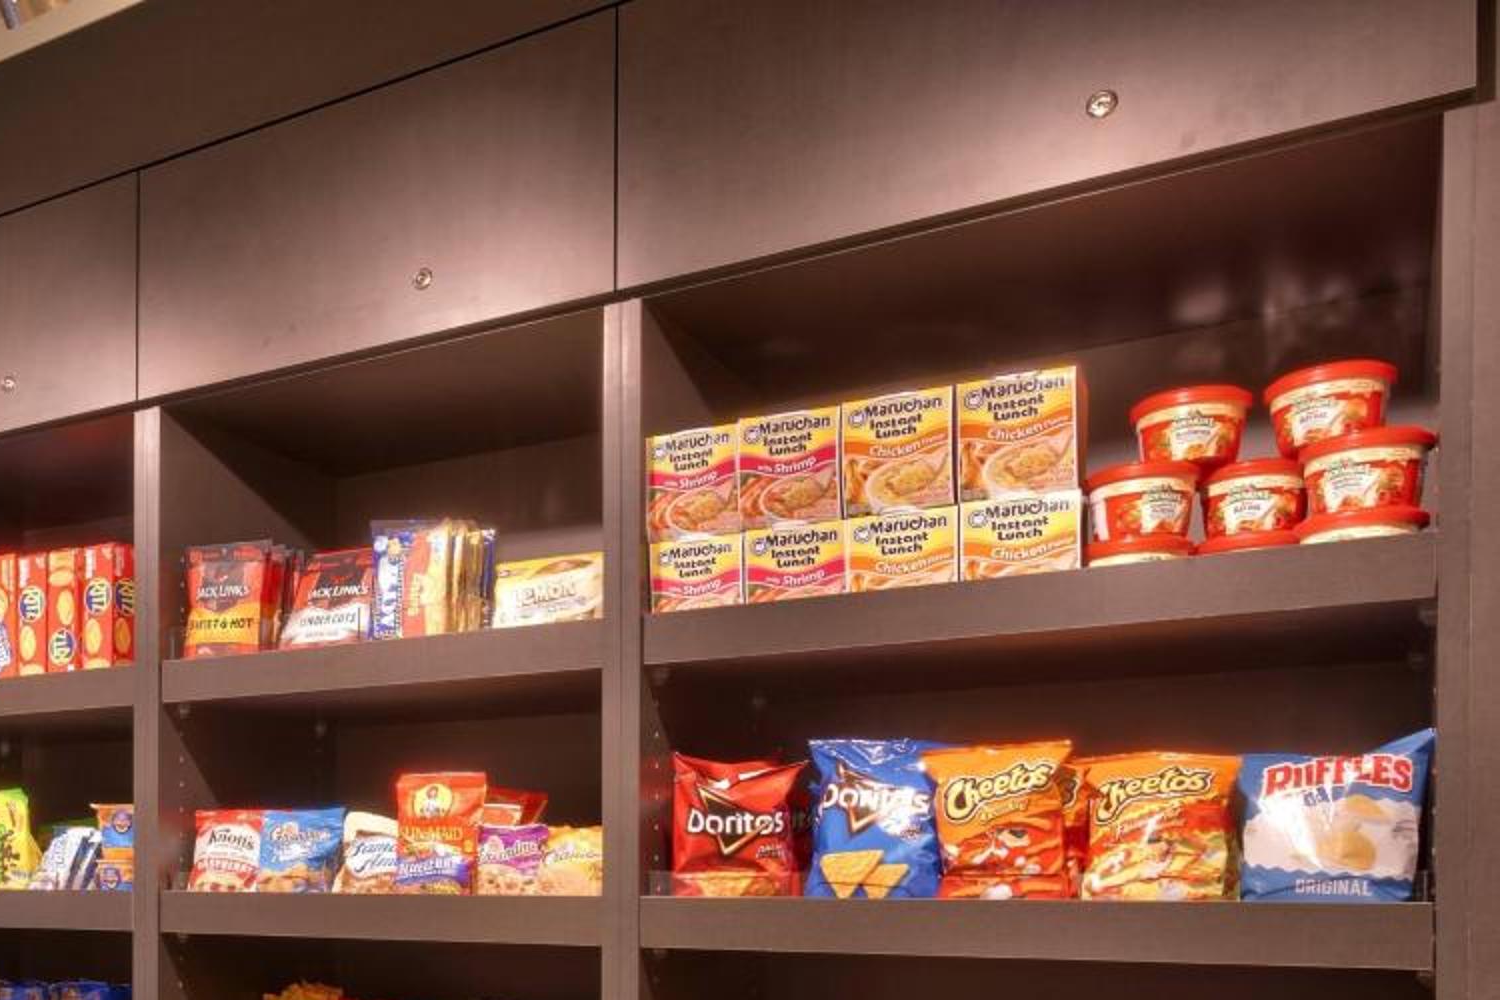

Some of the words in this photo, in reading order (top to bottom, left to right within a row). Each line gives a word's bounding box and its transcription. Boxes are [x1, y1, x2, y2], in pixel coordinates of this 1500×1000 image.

[981, 376, 1065, 399] Maruchan
[865, 397, 943, 417] Maruchan
[987, 394, 1044, 412] Instant
[869, 414, 923, 430] Instant
[993, 406, 1039, 421] Lunch
[759, 415, 831, 434] Maruchan
[875, 425, 917, 438] Lunch
[987, 424, 1042, 441] Chicken
[666, 432, 730, 453] Maruchan
[763, 431, 813, 445] Instant
[768, 442, 807, 455] Lunch
[869, 442, 920, 457] Chicken
[775, 456, 815, 474] Shrimp
[678, 471, 717, 488] Shrimp
[985, 499, 1070, 518] Maruchan
[870, 514, 947, 534] Maruchan
[991, 517, 1049, 531] Instant
[765, 528, 837, 547] Maruchan
[875, 532, 929, 546] Instant
[997, 528, 1043, 541] Lunch
[669, 542, 732, 560] Maruchan
[771, 545, 820, 559] Instant
[880, 542, 922, 555] Lunch
[992, 544, 1045, 560] Chicken
[776, 556, 815, 568] Lunch
[875, 557, 927, 574] Chicken
[782, 568, 825, 586] Shrimp
[516, 579, 577, 607] LEMON
[683, 579, 722, 596] Shrimp
[1265, 754, 1413, 796] RUFFLES
[946, 764, 1051, 821] Cheetos
[1097, 768, 1208, 822] Cheetos
[687, 808, 784, 835] Doritos
